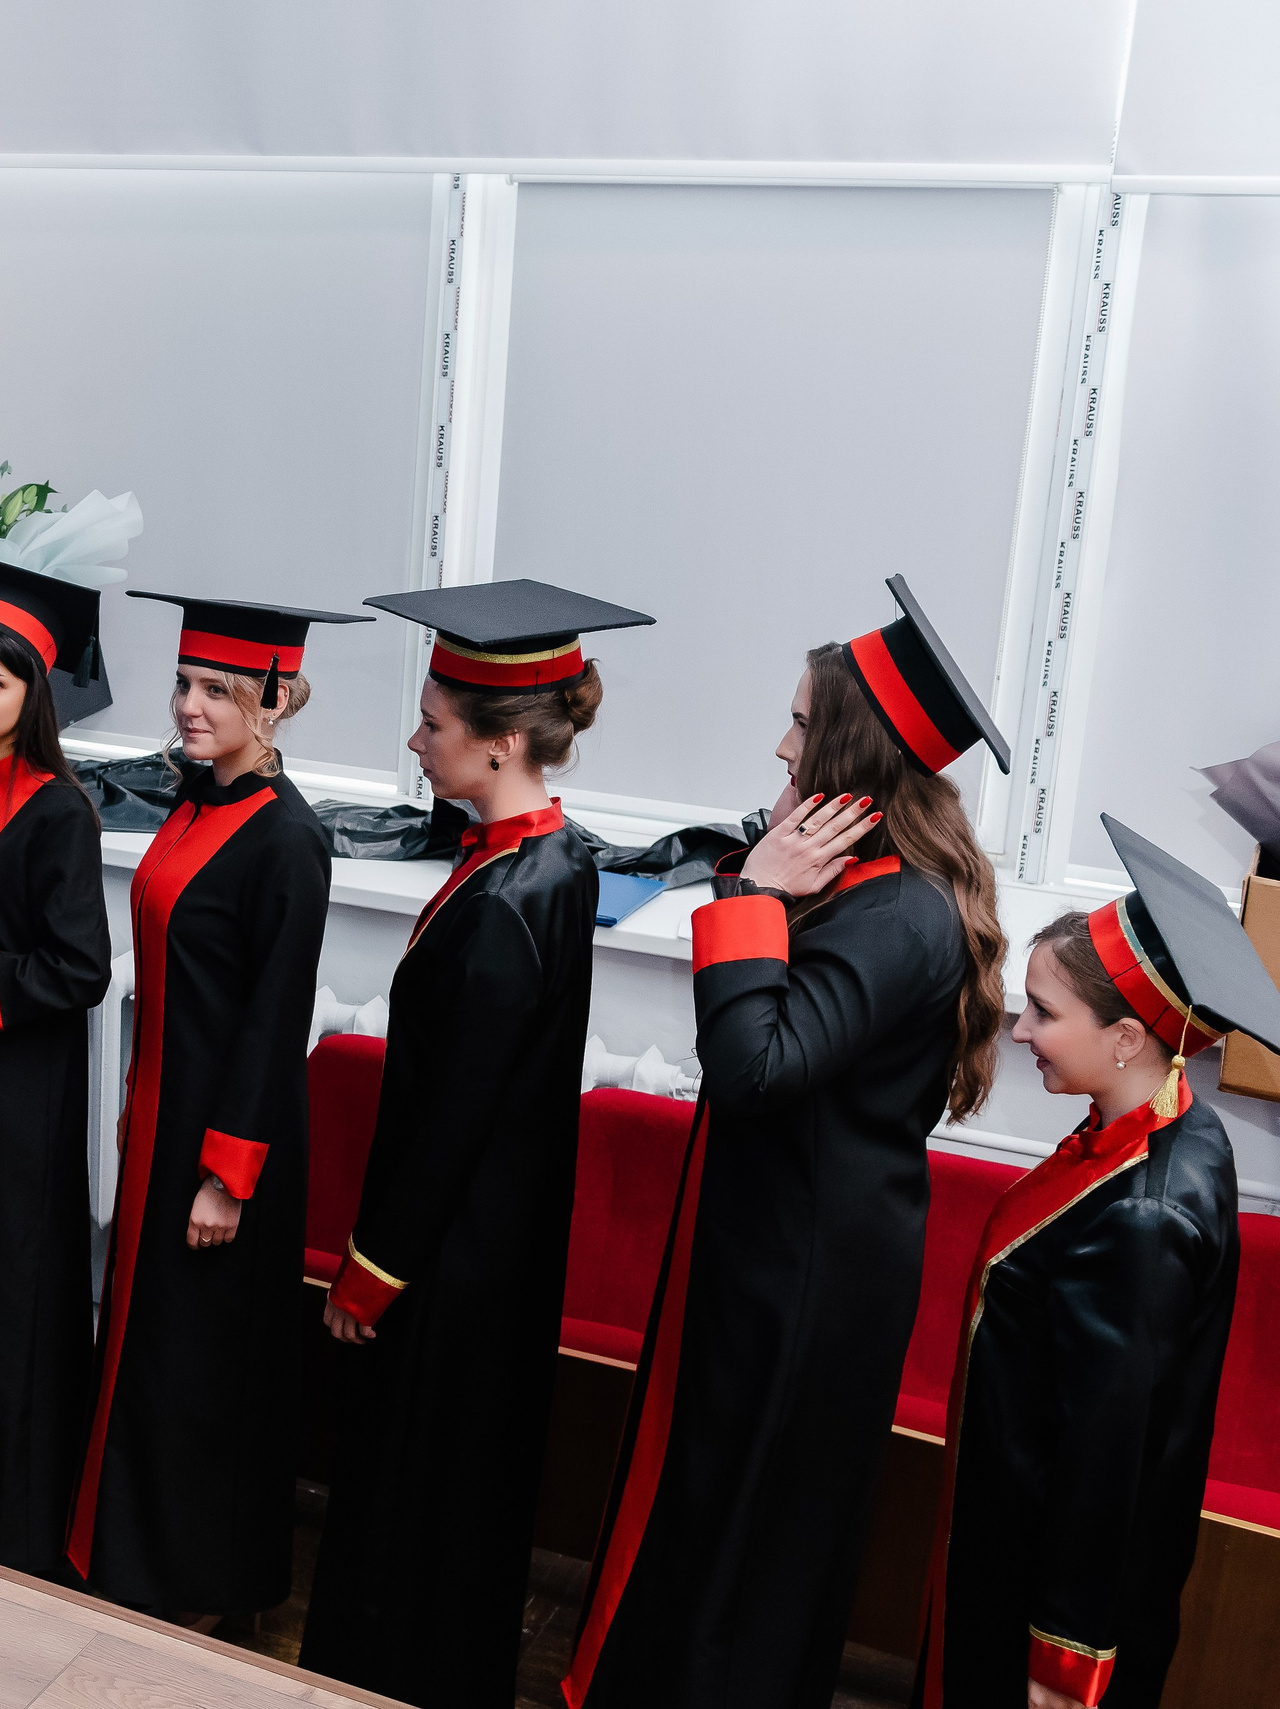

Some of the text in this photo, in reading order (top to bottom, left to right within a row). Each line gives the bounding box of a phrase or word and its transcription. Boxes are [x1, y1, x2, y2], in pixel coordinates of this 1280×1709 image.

[1111, 193, 1122, 227] AUSS
[447, 239, 456, 284] KRAUSS
[1099, 282, 1111, 333] KRAUSS
[441, 333, 451, 377] KRAUSS
[1086, 387, 1098, 437] KRAUSS
[436, 425, 445, 468] KRAUSS
[430, 515, 439, 557] KRAUSS
[1072, 491, 1085, 539] KRAUSS
[1059, 592, 1072, 639] KRAUSS
[1047, 690, 1059, 737] KRAUSS
[1035, 788, 1046, 834] KRAUSS
